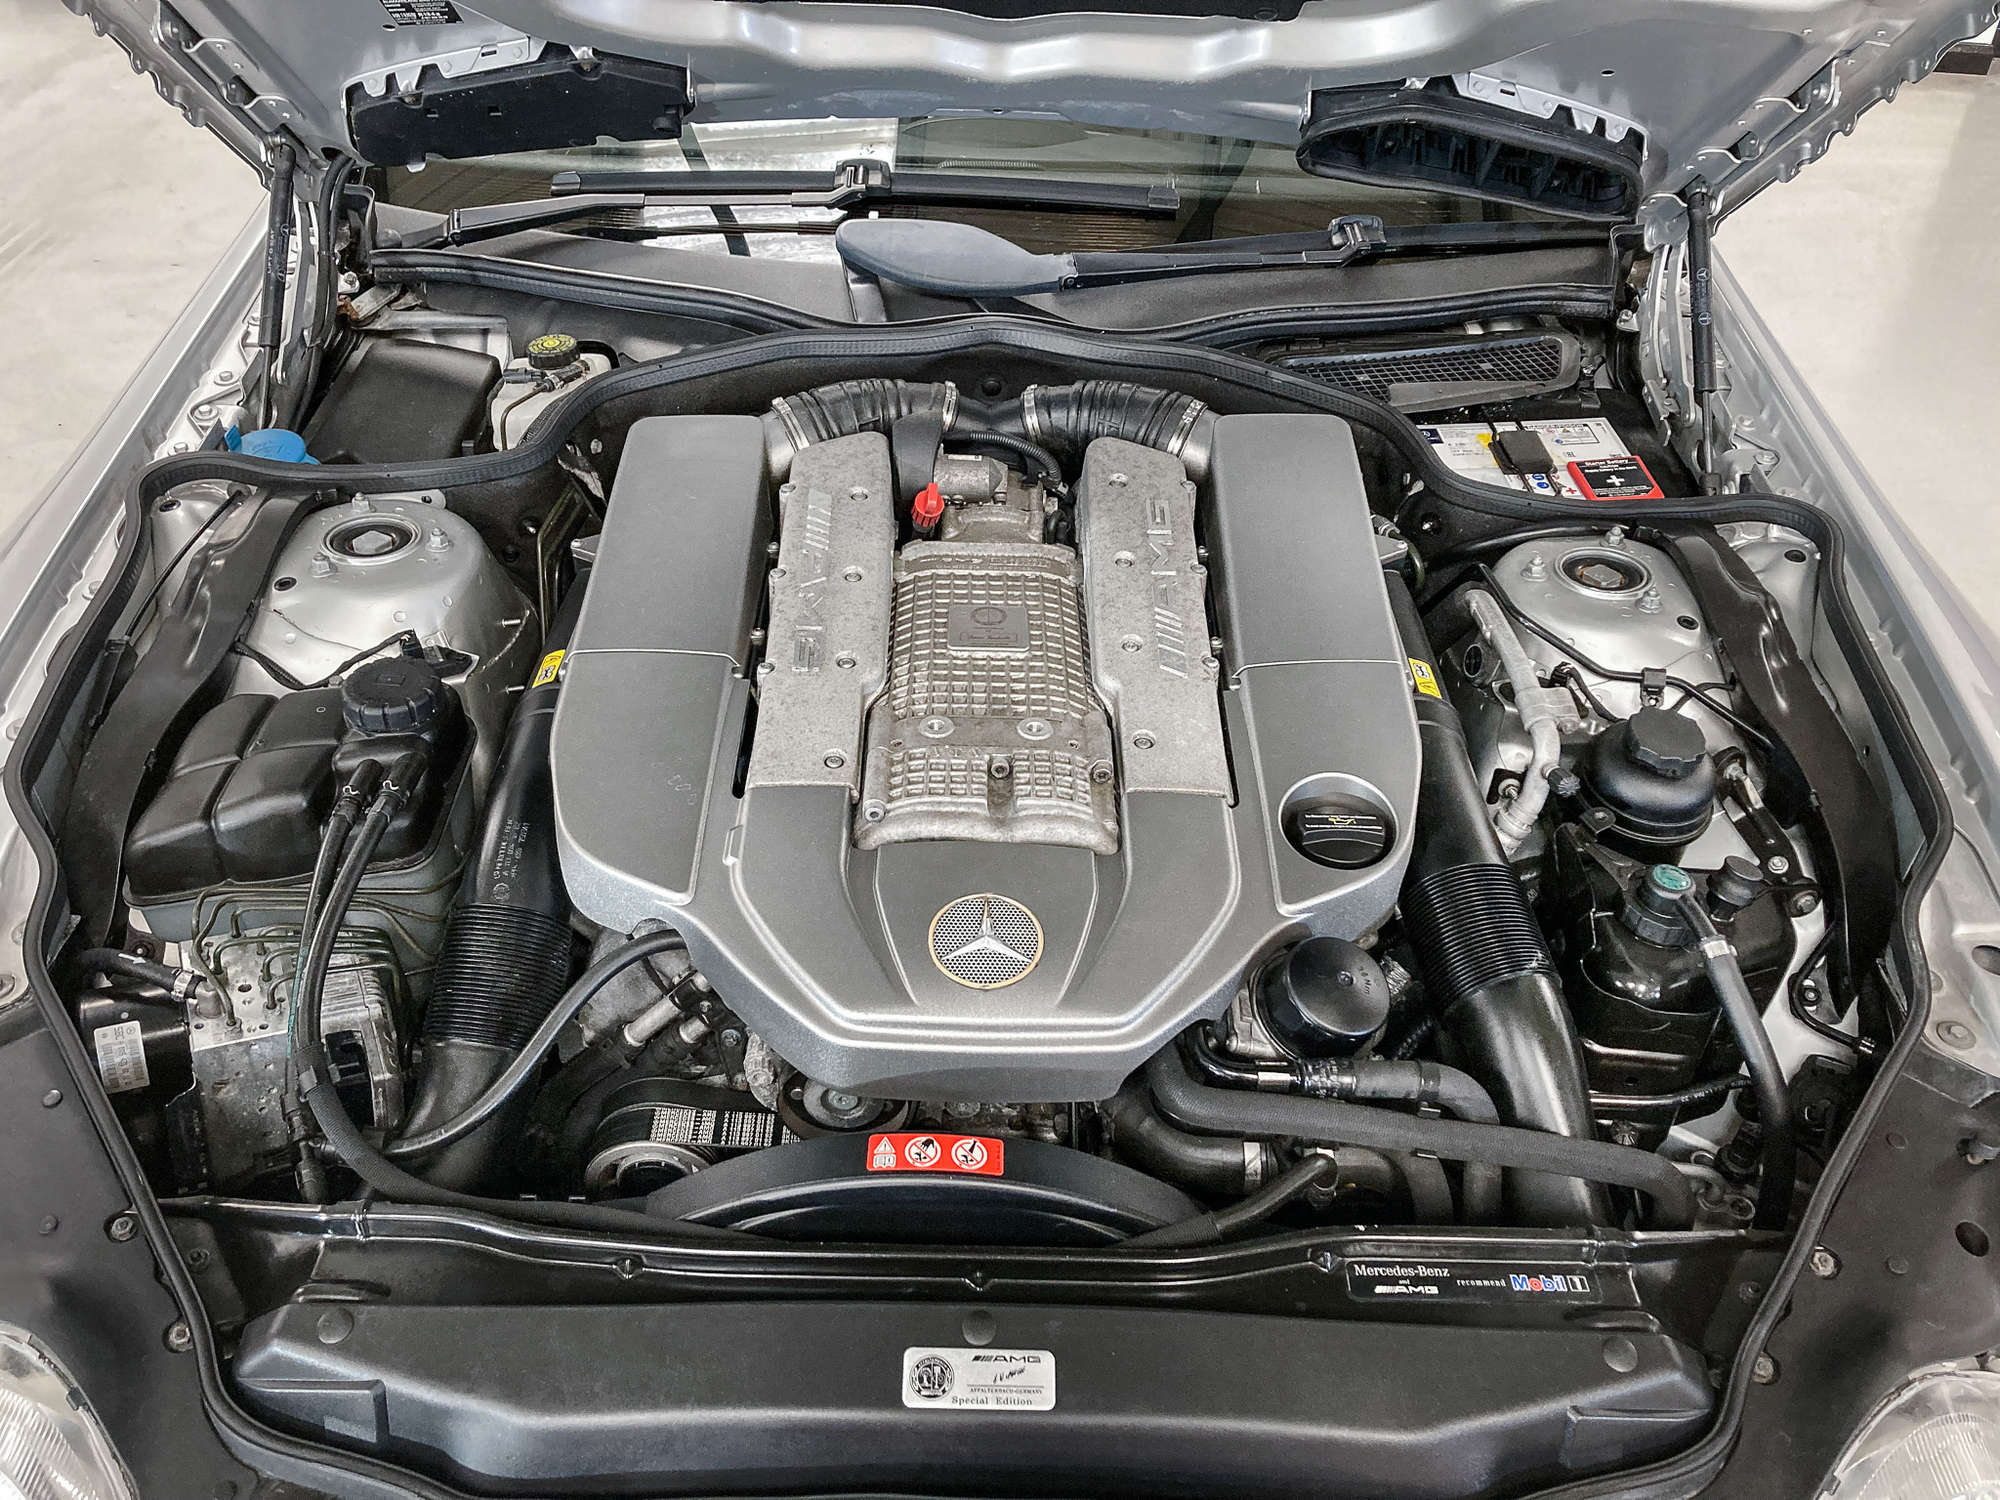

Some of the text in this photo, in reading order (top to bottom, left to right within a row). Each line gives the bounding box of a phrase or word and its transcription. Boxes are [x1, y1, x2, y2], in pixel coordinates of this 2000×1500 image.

[1145, 499, 1177, 607] AMG
[791, 549, 827, 672] AMG
[1354, 1264, 1450, 1277] Mercedes-Benz
[1394, 1285, 1439, 1294] AMG
[1456, 1278, 1506, 1287] recommend
[1509, 1274, 1568, 1292] Mobil
[993, 1355, 1041, 1363] AMG
[952, 1396, 1033, 1406] Special Edition
